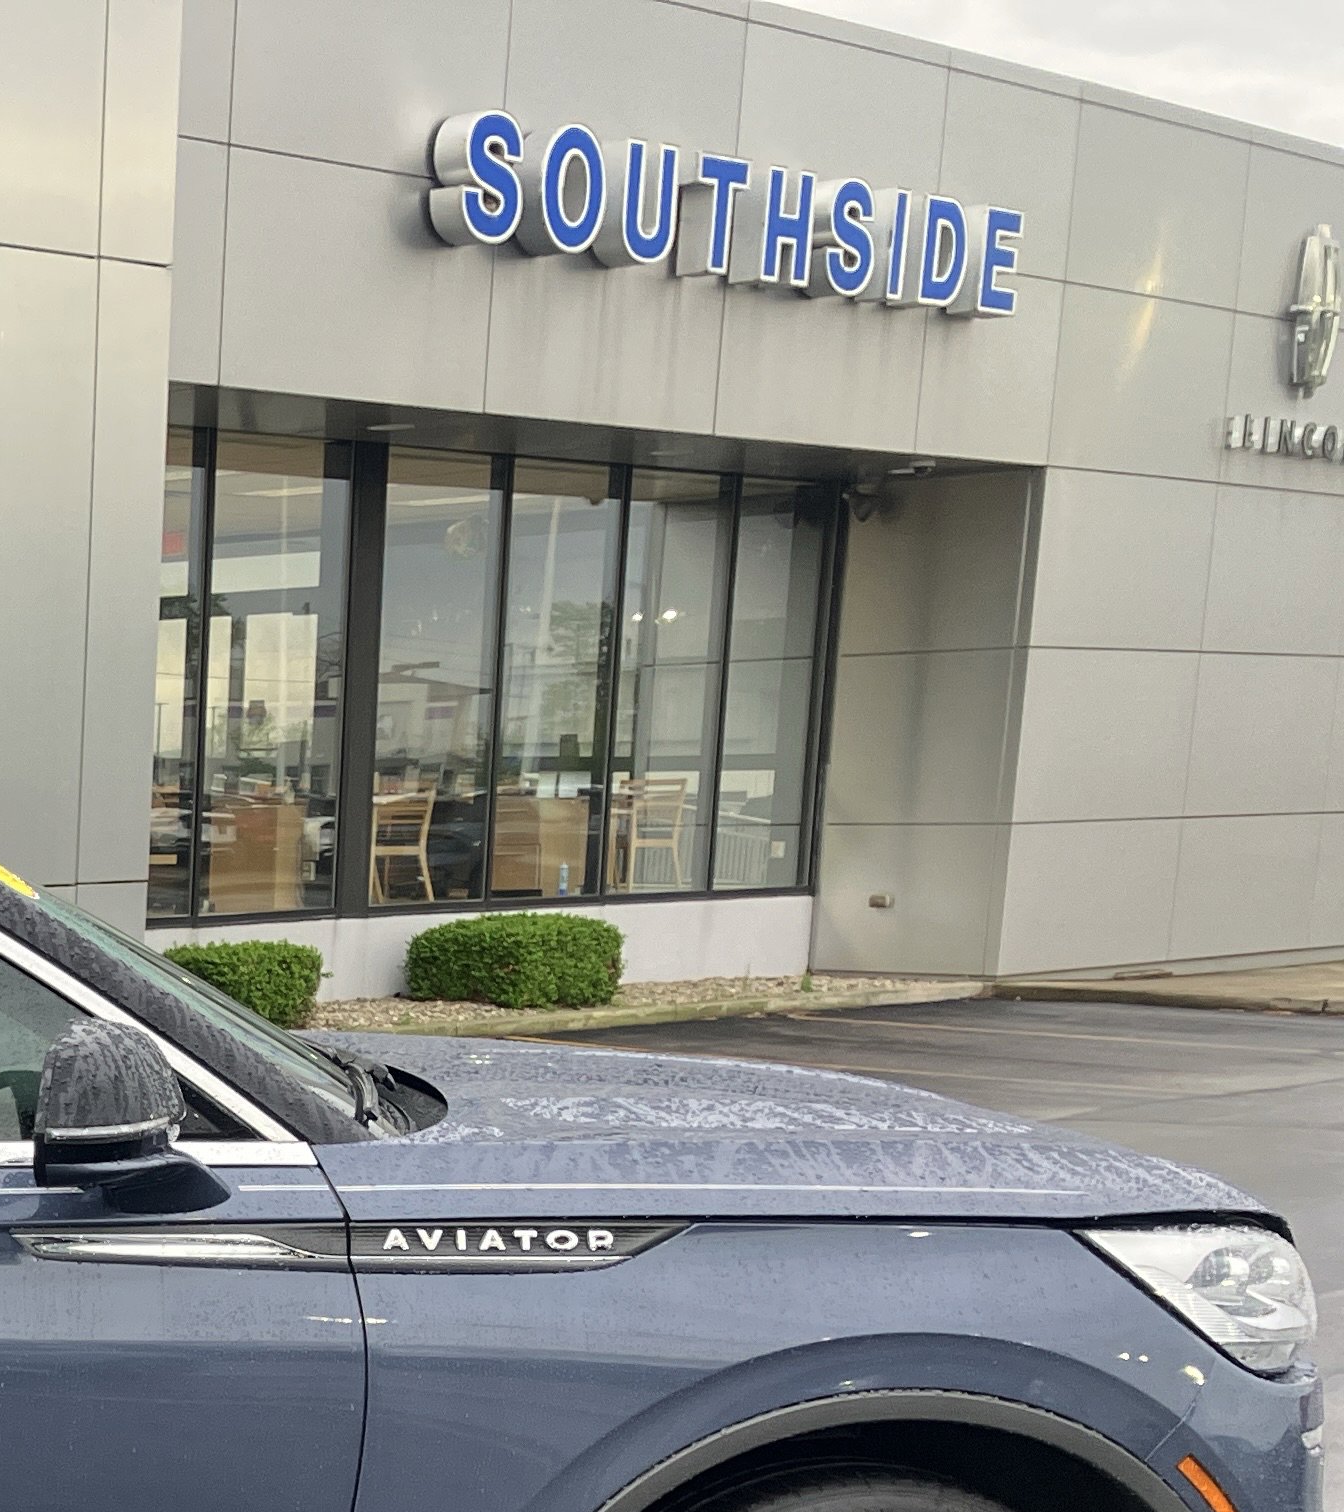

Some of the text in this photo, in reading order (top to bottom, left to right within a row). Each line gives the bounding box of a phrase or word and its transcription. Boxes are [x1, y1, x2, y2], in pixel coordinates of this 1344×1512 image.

[460, 107, 1026, 317] SOUTHSIDE
[1230, 412, 1344, 464] LINCO
[382, 1227, 614, 1252] AVIATOR
